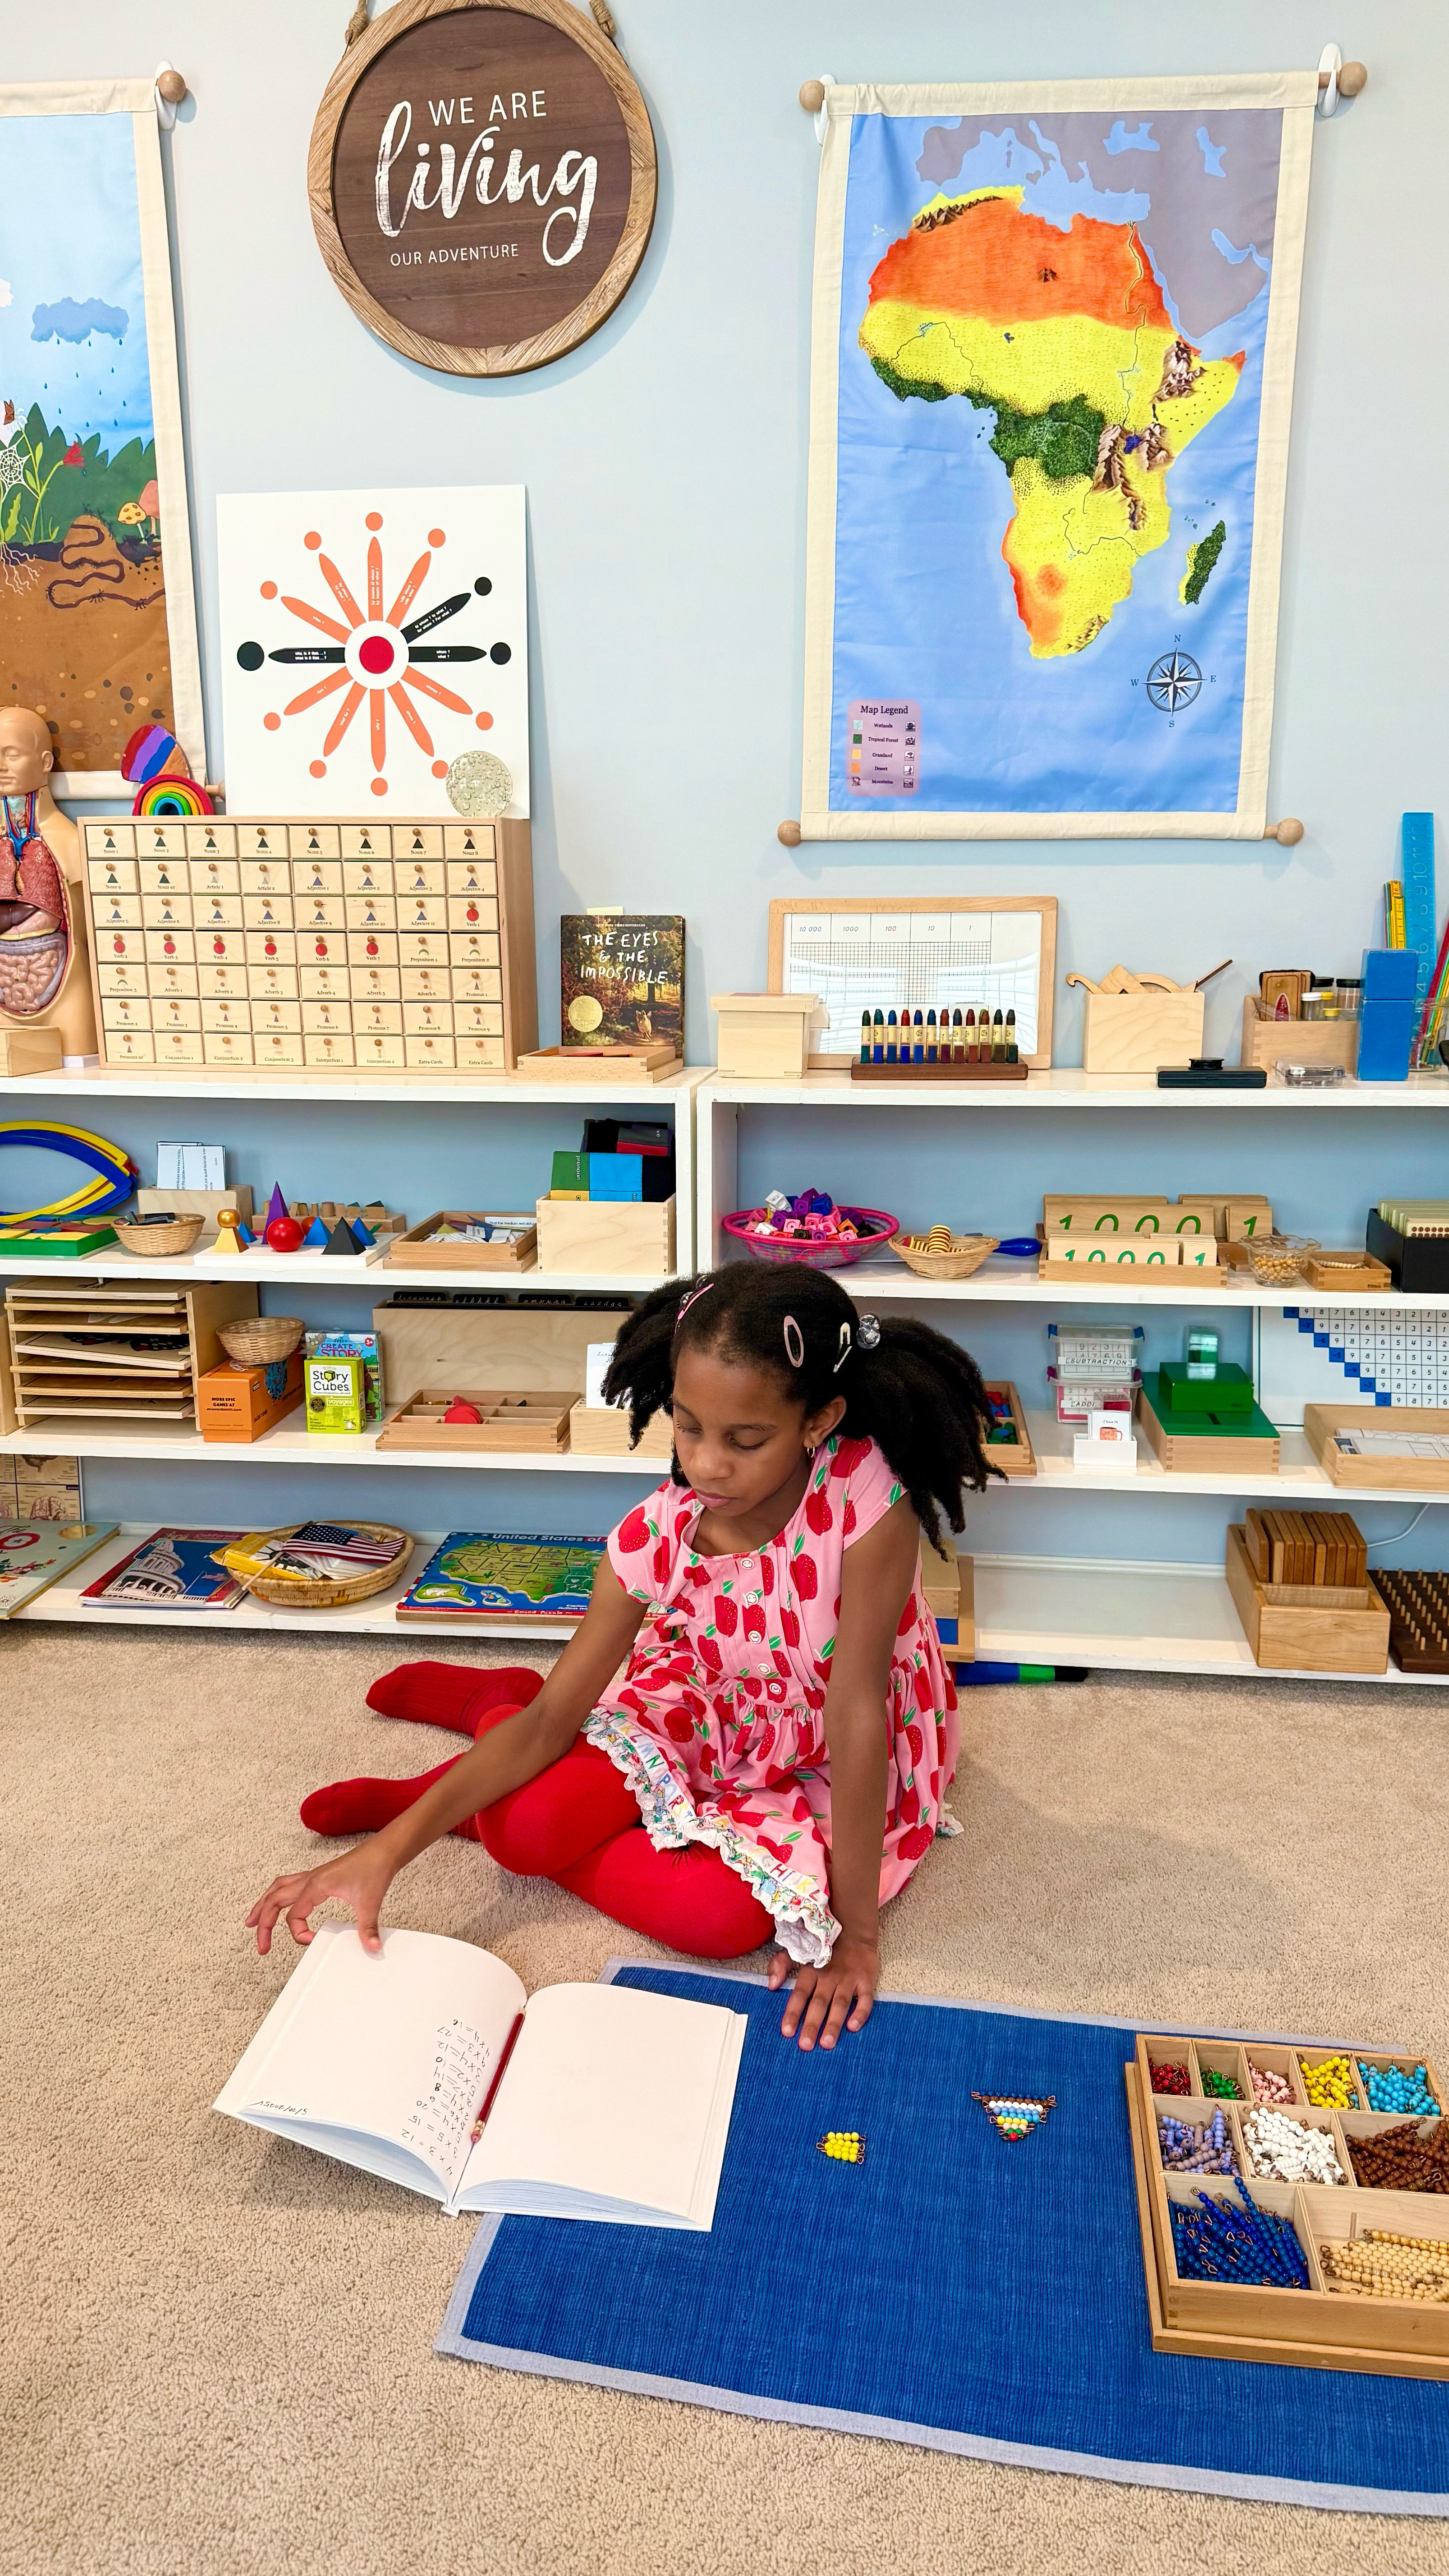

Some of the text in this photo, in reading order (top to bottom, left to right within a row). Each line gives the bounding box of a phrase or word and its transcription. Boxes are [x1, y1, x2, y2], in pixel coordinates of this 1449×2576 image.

[428, 90, 547, 127] WE ARE
[375, 100, 598, 267] living
[390, 244, 518, 267] OUR ADVENTURE
[860, 705, 908, 715] Map Legend
[1412, 862, 1427, 880] 10
[1413, 885, 1427, 896] 9
[582, 930, 658, 948] THE EYES
[599, 950, 646, 963] & THE
[580, 965, 668, 985] IMPOSSIBLE
[1418, 962, 1429, 973] 5
[1416, 984, 1426, 993] 4
[313, 1381, 349, 1391] Cubes
